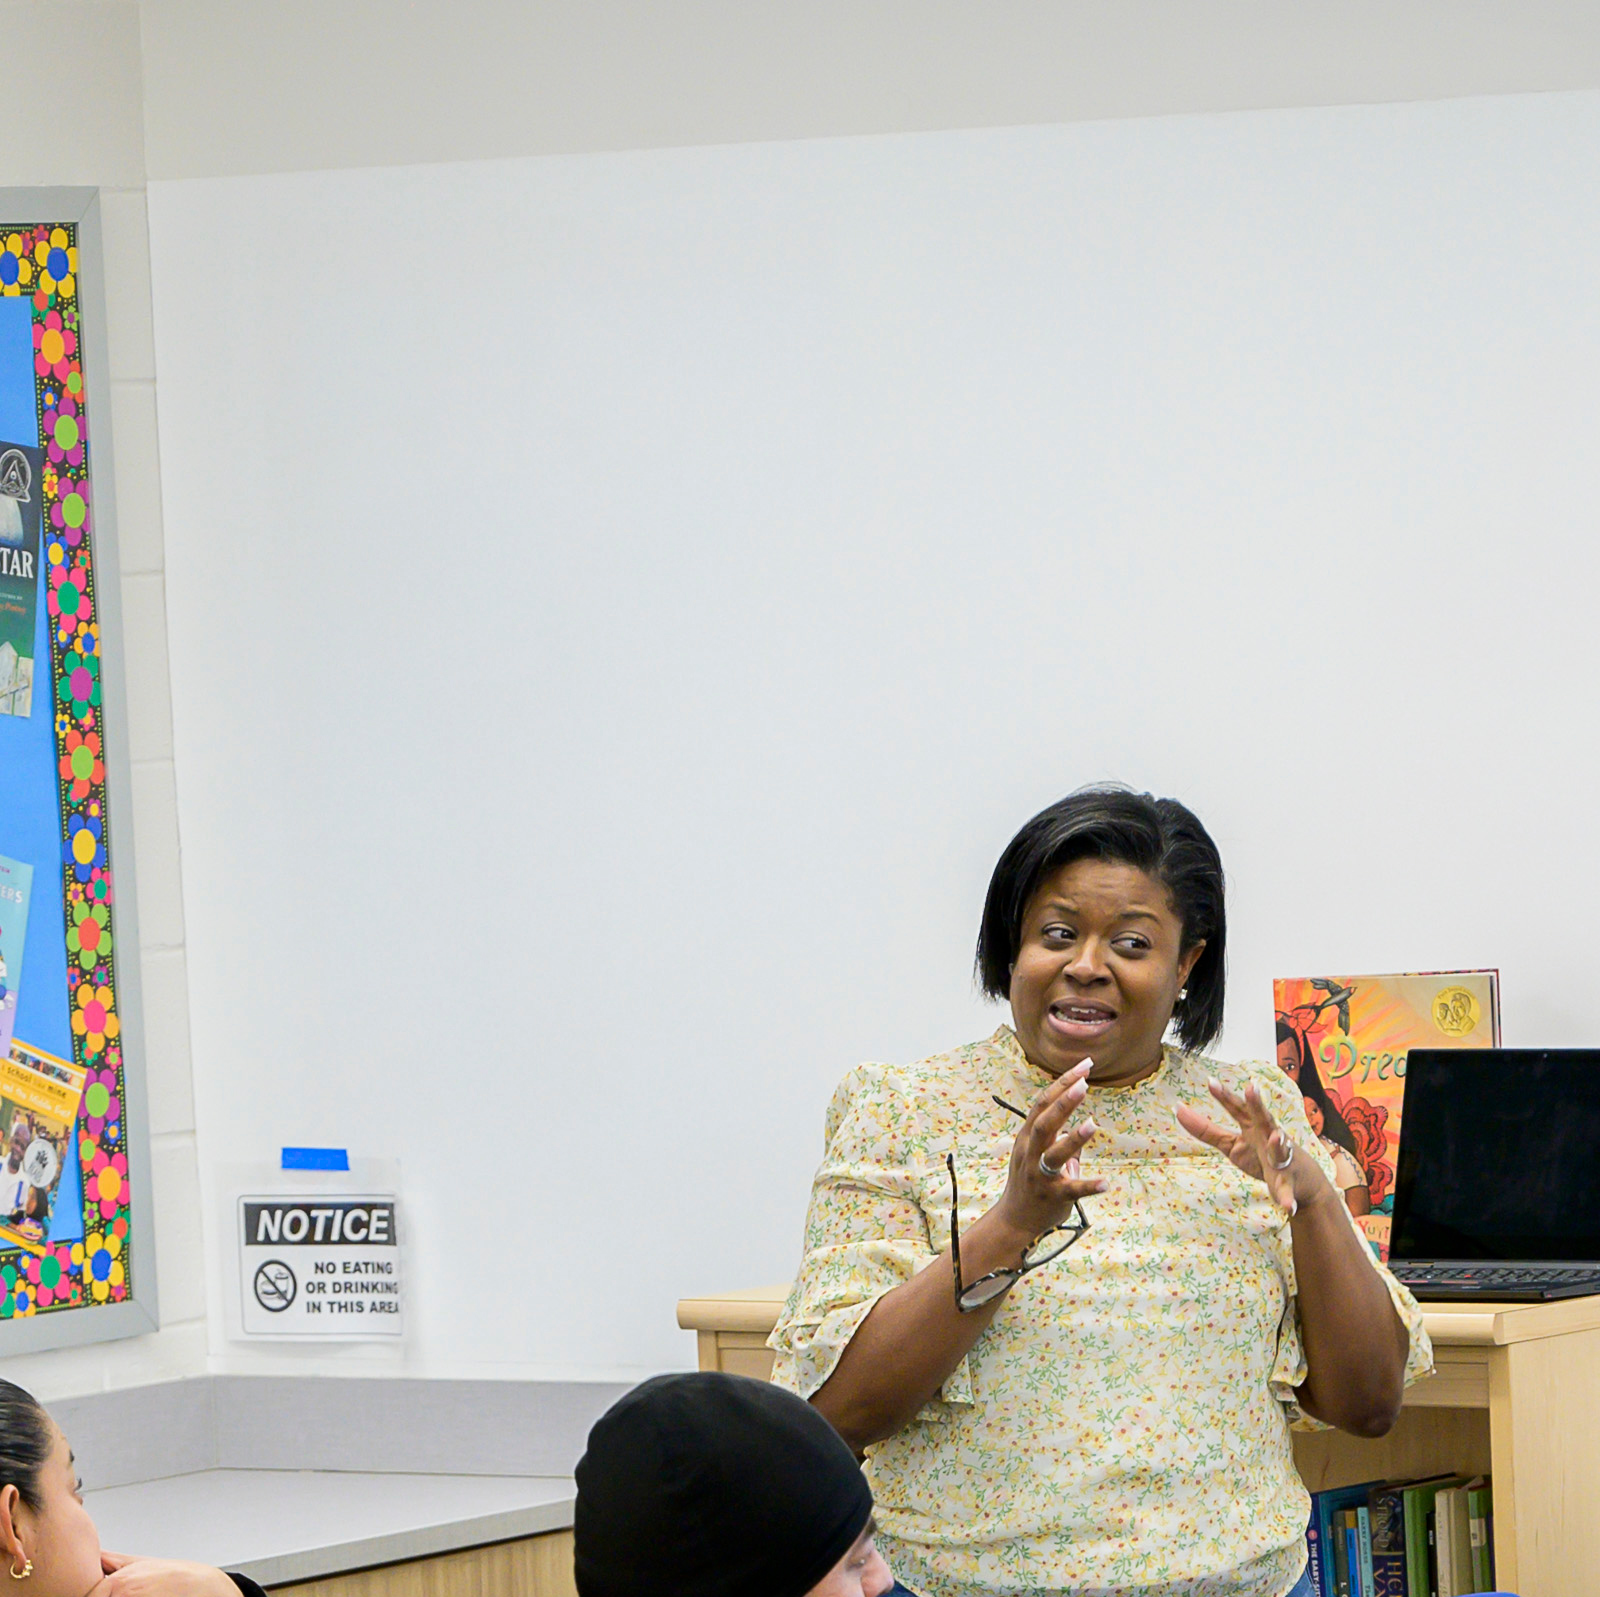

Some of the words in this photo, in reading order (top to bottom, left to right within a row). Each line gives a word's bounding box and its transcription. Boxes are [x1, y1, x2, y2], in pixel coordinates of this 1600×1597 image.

[257, 1209, 389, 1241] NOTICE
[315, 1262, 336, 1274] NO
[343, 1262, 392, 1274] EATING
[306, 1282, 326, 1294] OR
[307, 1302, 321, 1313] IN
[327, 1301, 364, 1313] THIS
